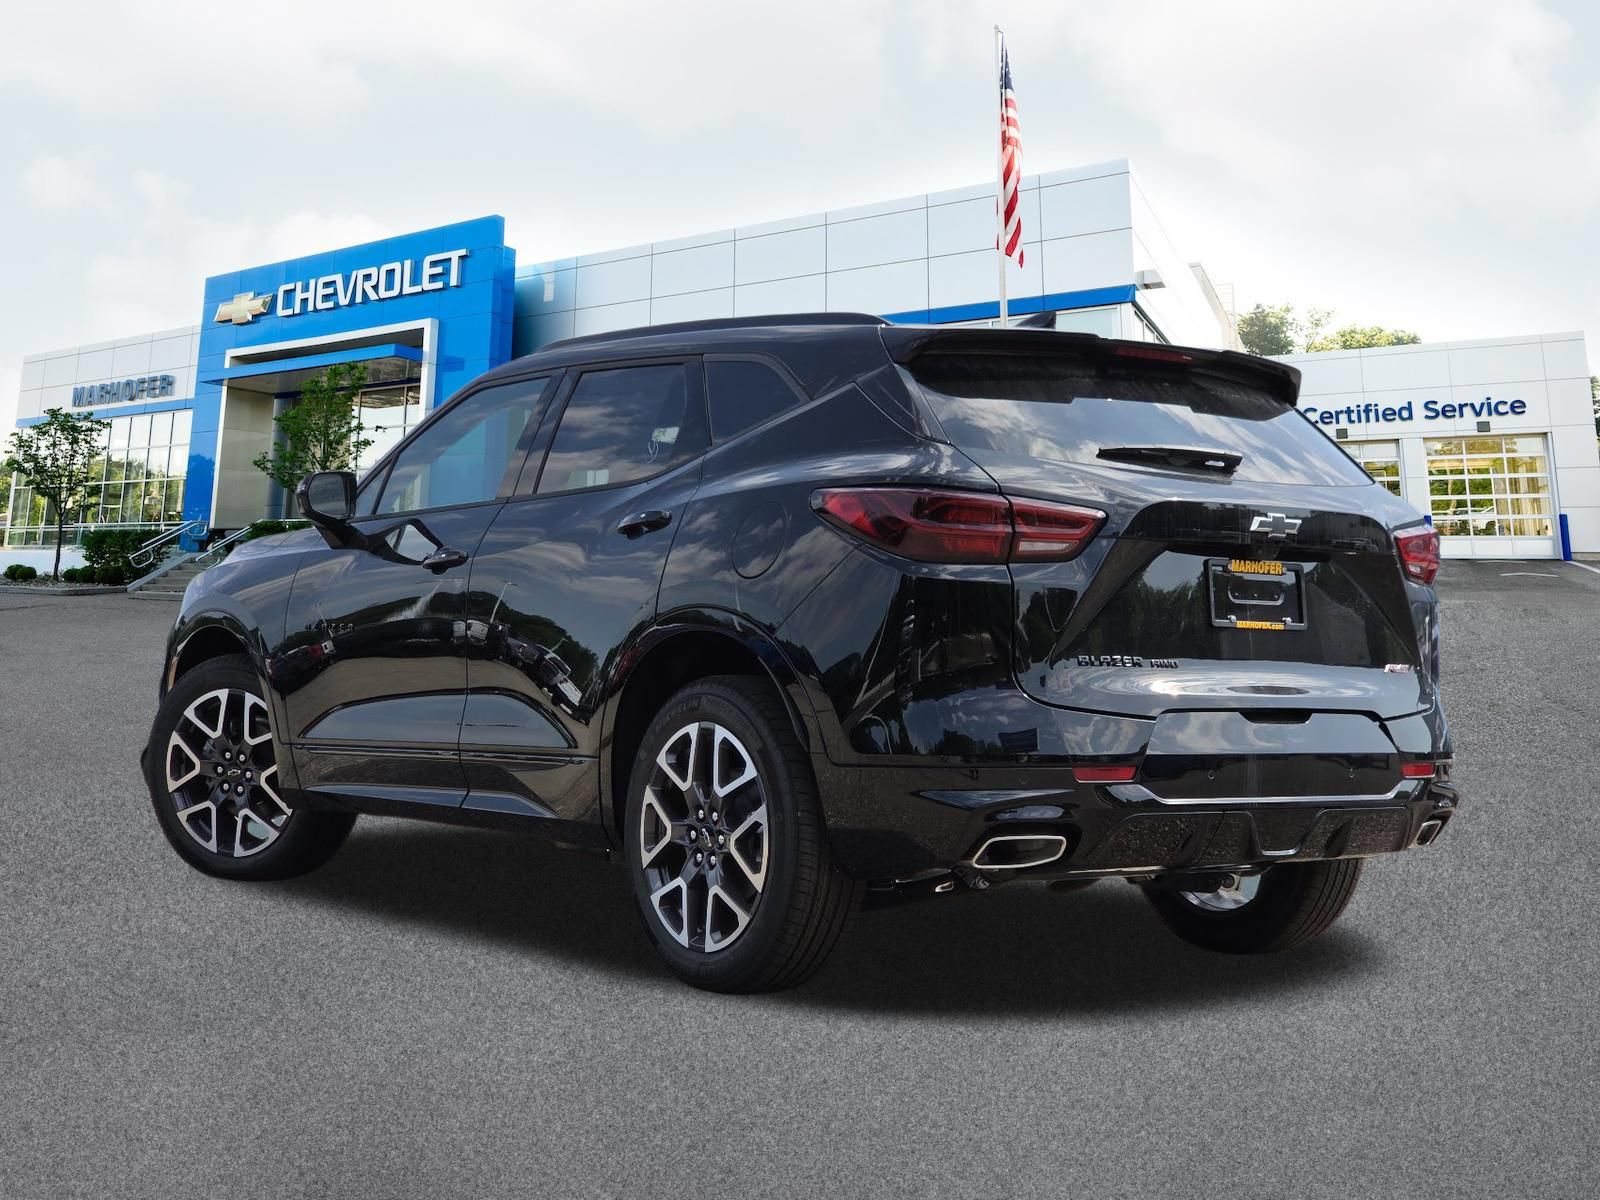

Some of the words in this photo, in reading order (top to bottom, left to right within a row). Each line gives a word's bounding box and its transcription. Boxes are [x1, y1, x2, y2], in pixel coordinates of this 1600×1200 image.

[277, 248, 469, 317] CHEVROLET
[72, 374, 176, 408] MARHOFER
[1302, 401, 1414, 425] Certified
[1424, 396, 1527, 420] Service
[1230, 559, 1283, 575] MARHOFER
[1077, 655, 1144, 668] BLAZER
